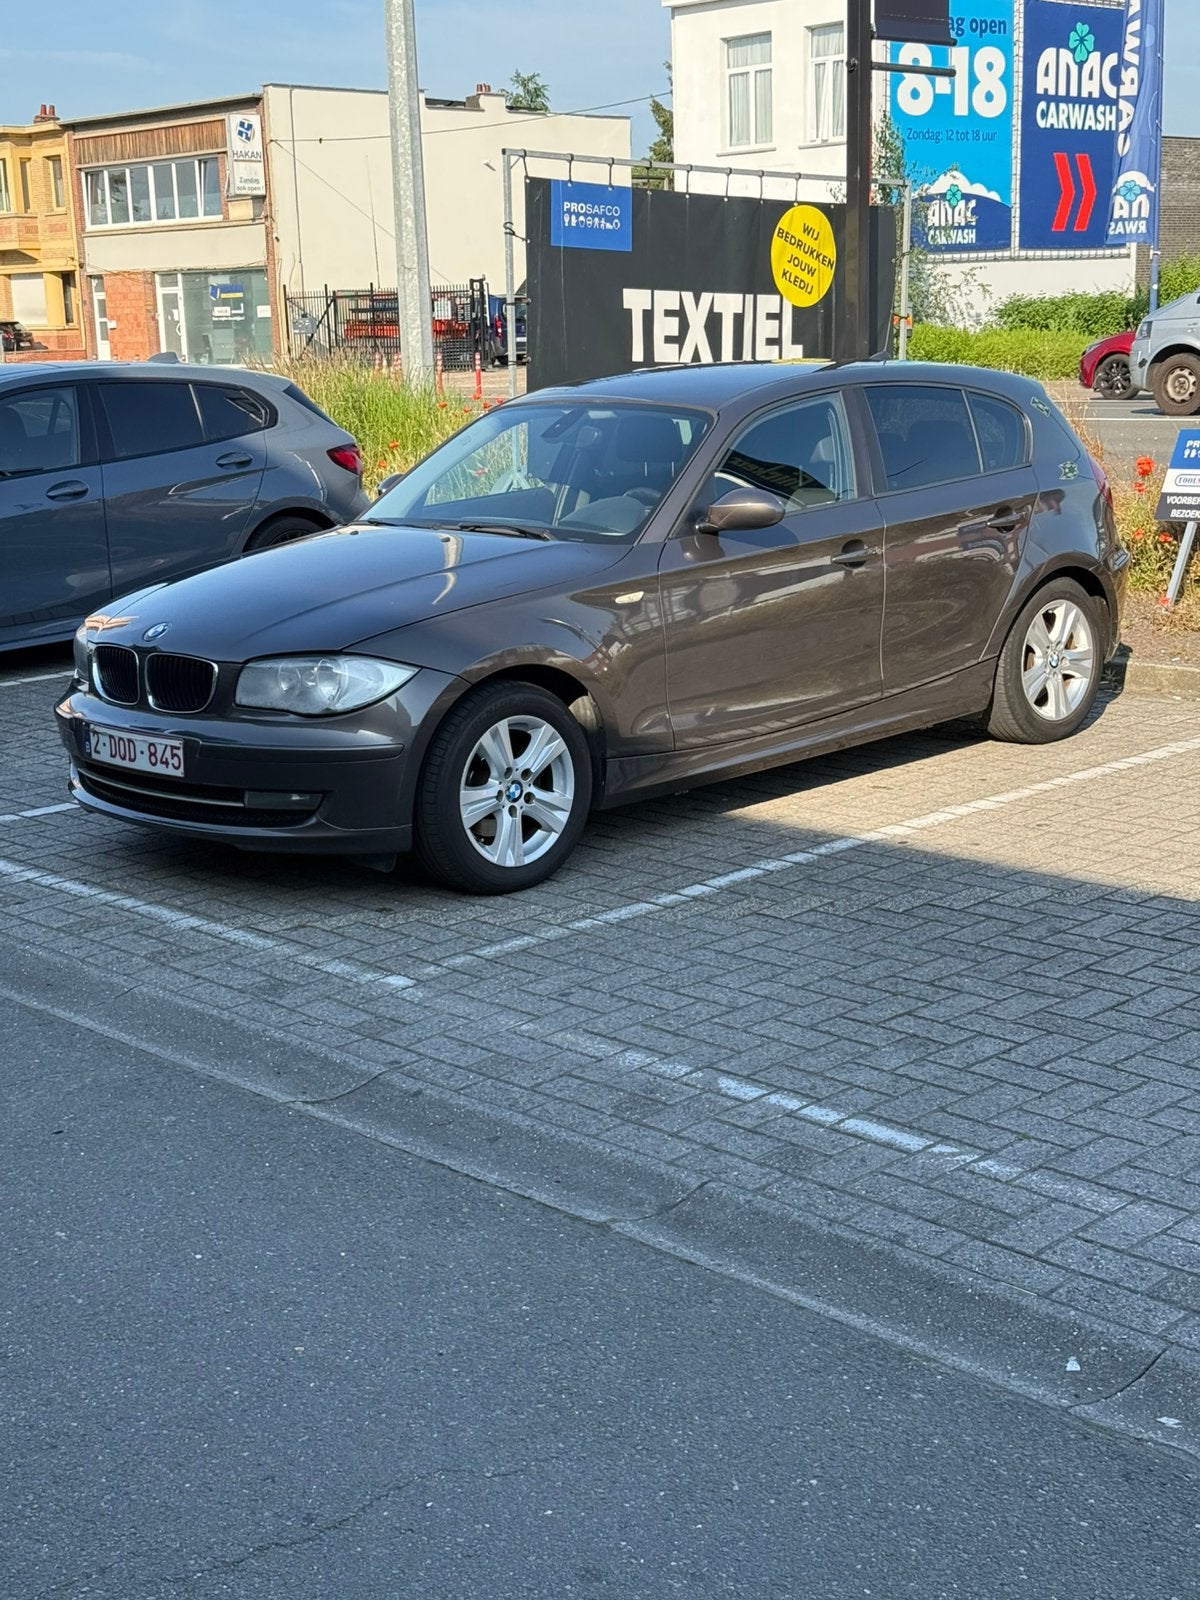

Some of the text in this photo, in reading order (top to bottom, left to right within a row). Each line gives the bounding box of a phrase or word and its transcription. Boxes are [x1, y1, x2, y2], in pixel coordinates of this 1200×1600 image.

[970, 18, 1007, 38] open
[897, 42, 1006, 118] 8-18
[1036, 47, 1118, 99] ANAC
[1036, 101, 1116, 132] CARWASH
[906, 128, 998, 144] Zondag: 12 tot 18 uur
[232, 150, 262, 160] HAKAN
[564, 202, 620, 217] PROSAFCO
[928, 199, 976, 226] ANAC
[802, 222, 820, 241] WIJ
[776, 227, 835, 270] BEDRUKKEN
[787, 254, 817, 277] JOUW
[781, 268, 815, 296] KLEDIJ
[622, 288, 804, 363] TEXTIEL
